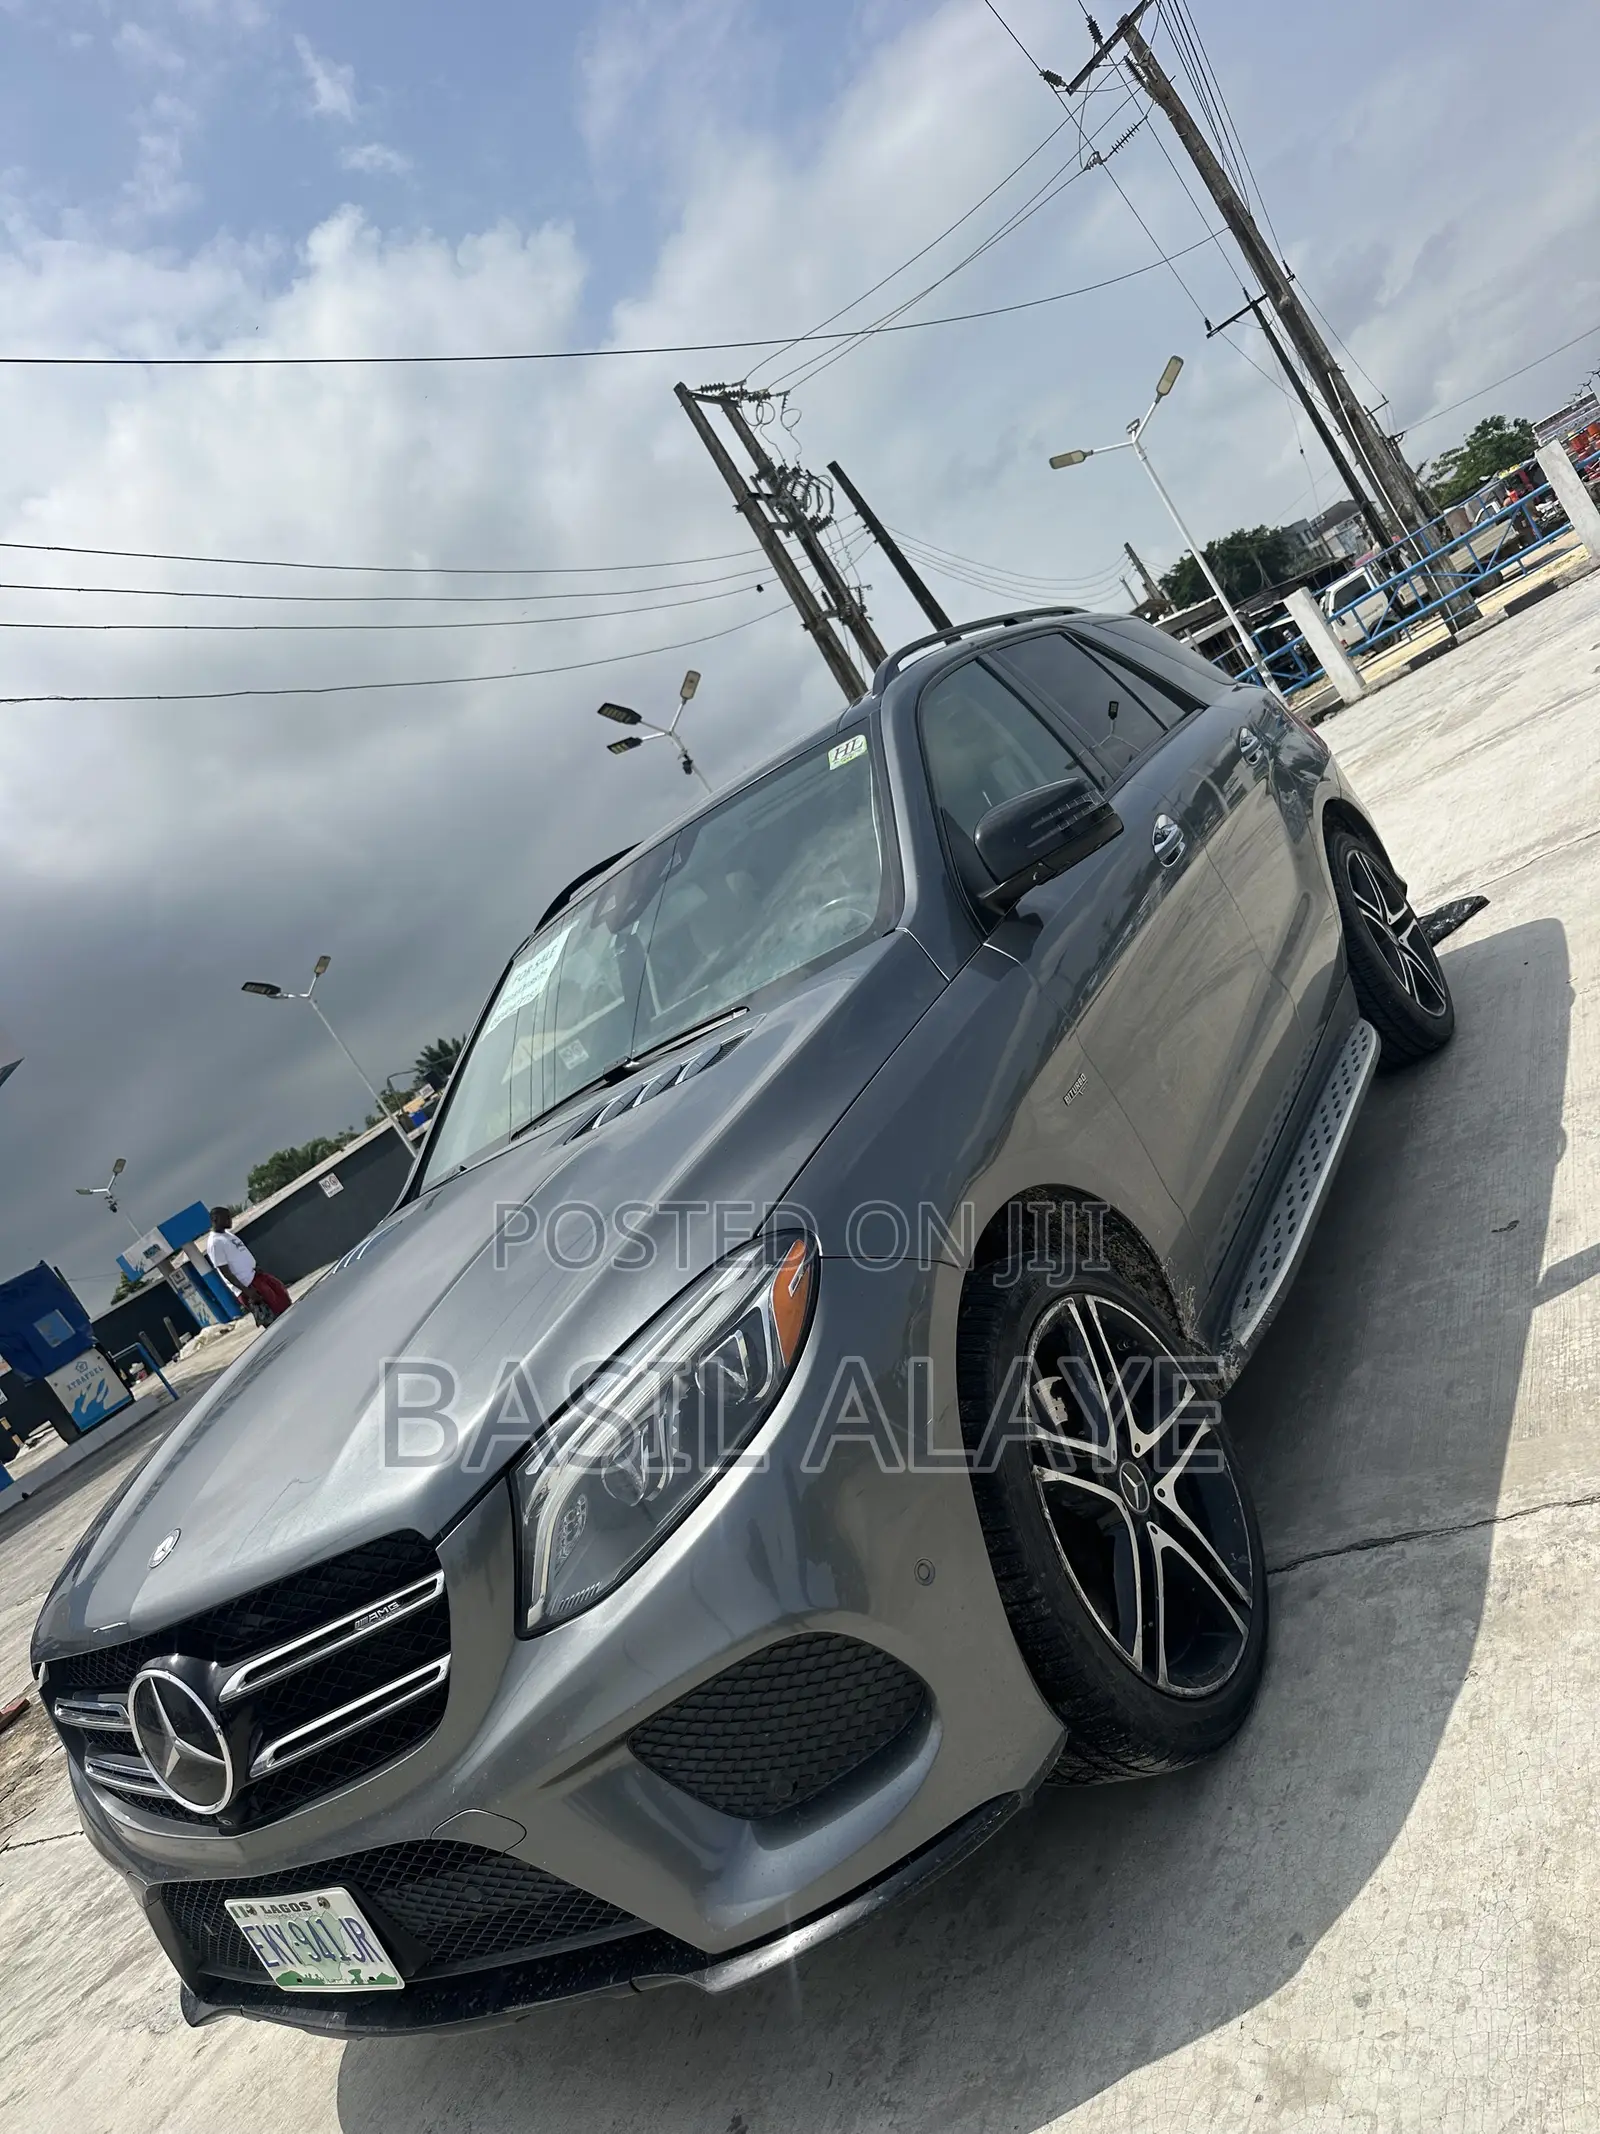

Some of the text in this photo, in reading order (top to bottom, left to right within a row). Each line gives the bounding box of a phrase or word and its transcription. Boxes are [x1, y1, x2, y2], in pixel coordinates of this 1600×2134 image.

[1063, 1072, 1087, 1106] BITURBO
[368, 1601, 400, 1621] AMG
[260, 1901, 312, 1914] LAGOS
